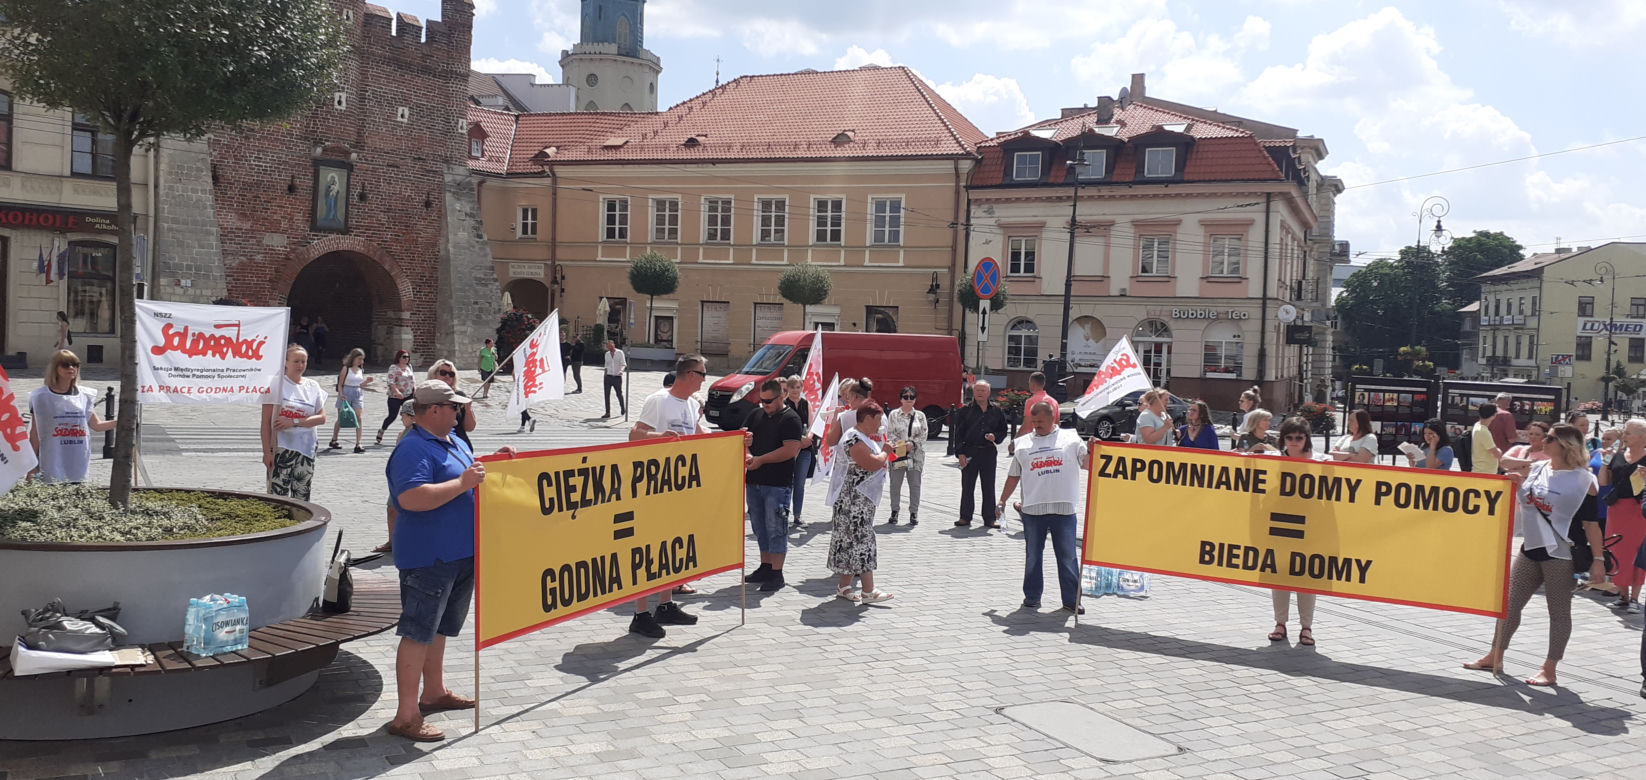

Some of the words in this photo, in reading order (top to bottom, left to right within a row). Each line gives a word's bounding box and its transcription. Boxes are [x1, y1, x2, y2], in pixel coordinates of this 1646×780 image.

[85, 216, 110, 224] Dolina
[1172, 307, 1217, 320] Bubble
[1227, 308, 1249, 320] Tea
[140, 385, 154, 394] ZA
[158, 385, 193, 395] PRACĘ
[197, 385, 235, 394] GODNA
[238, 385, 271, 394] PŁACA
[537, 456, 622, 520] CIĘŻKA
[631, 453, 702, 499] PRACA
[1037, 468, 1060, 477] LUBLIN
[1098, 454, 1267, 495] ZAPOMNIANE
[1279, 471, 1363, 503] DOMY
[1374, 480, 1503, 517] POMOCY
[541, 551, 623, 614] GODNA
[631, 533, 698, 587] PŁACA
[1198, 540, 1278, 575] BIEDA
[1289, 551, 1373, 585] DOMY
